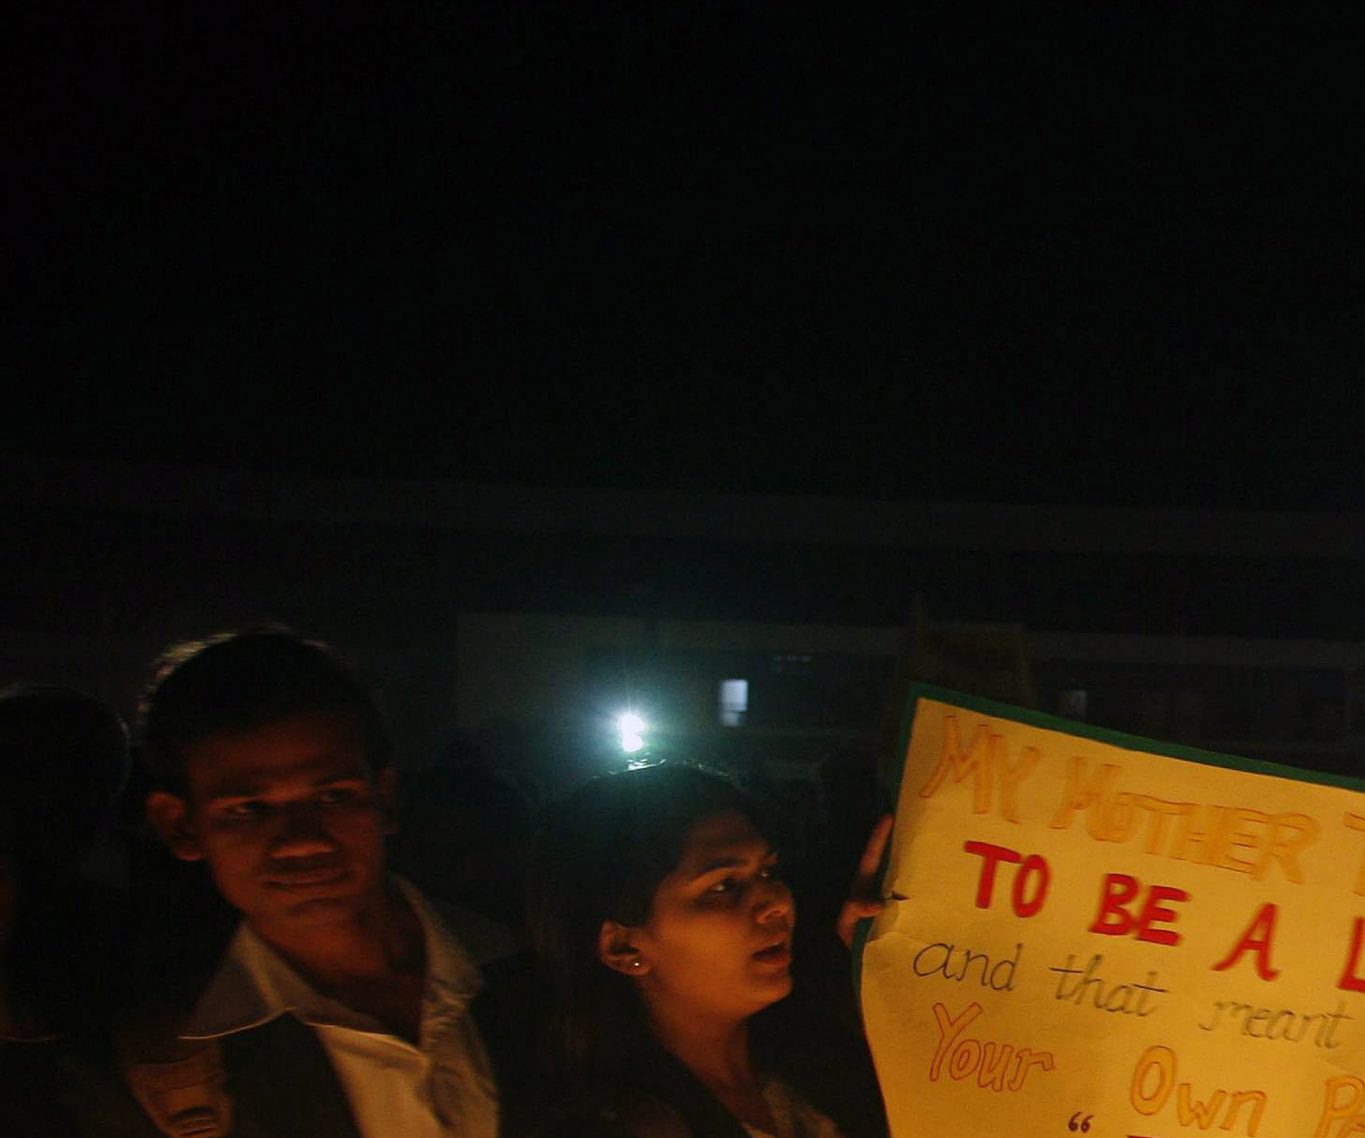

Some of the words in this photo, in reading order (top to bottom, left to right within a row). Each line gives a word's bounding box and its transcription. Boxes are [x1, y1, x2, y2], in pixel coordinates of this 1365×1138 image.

[920, 715, 1040, 824] MY
[1050, 761, 1319, 885] MOTHER
[963, 840, 1051, 919] TO
[1090, 873, 1190, 947] BE
[1212, 903, 1280, 982] A
[911, 940, 1024, 995] and
[1050, 952, 1169, 1019] that
[1199, 995, 1353, 1053] meant
[928, 1002, 1056, 1095] Your
[1130, 1044, 1267, 1138] Own
